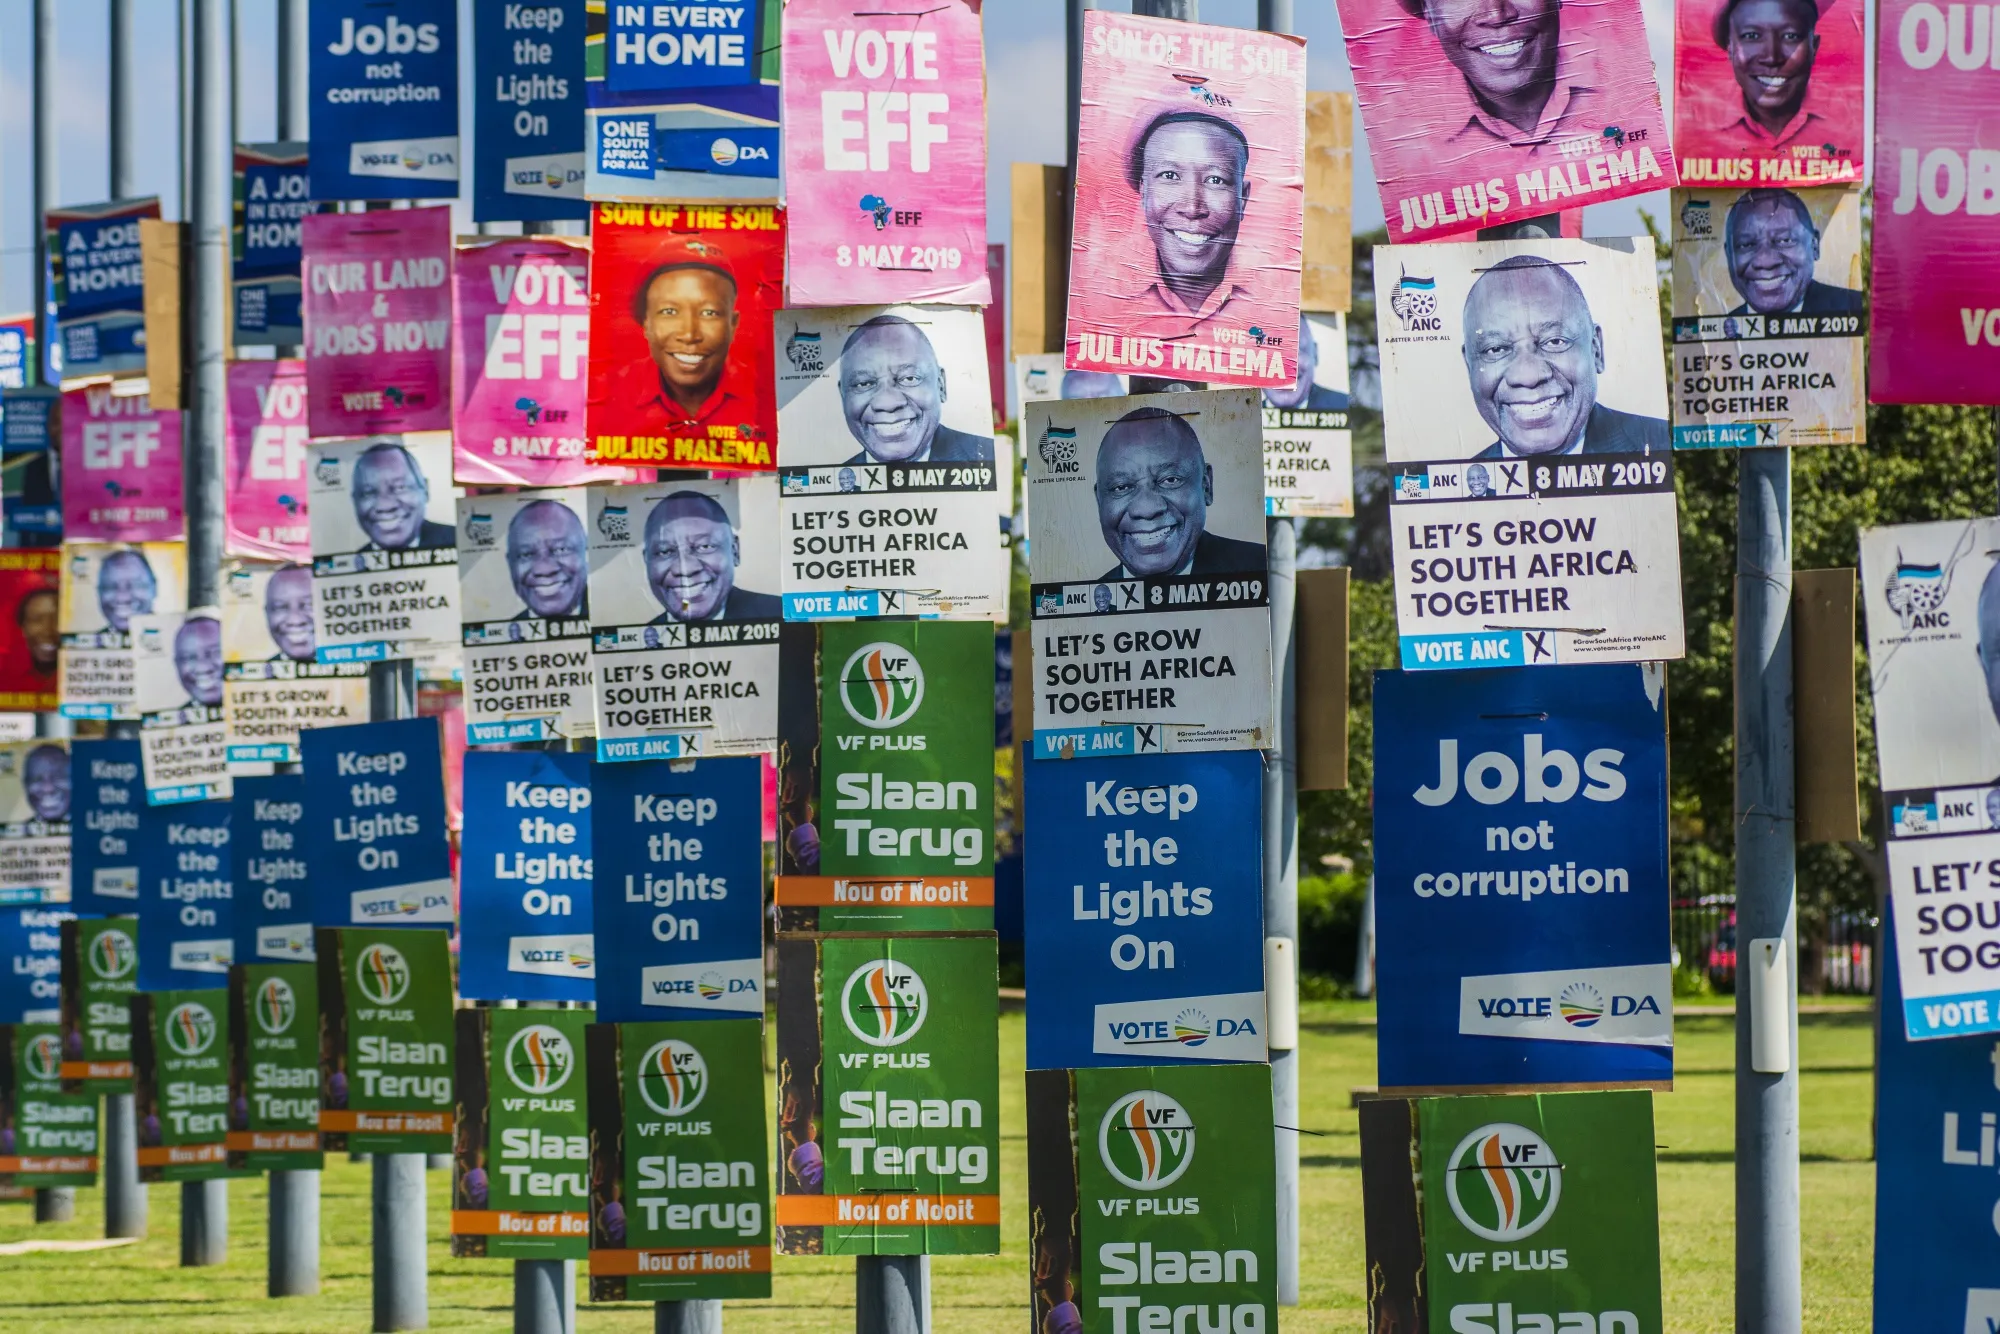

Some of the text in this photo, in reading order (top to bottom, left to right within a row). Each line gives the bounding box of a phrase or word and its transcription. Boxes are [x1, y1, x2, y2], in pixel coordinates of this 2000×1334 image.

[505, 4, 564, 32] Keep
[617, 6, 745, 28] IN EVERY
[328, 16, 439, 54] Jobs
[513, 39, 552, 64] the
[616, 33, 744, 66] HOME
[823, 30, 939, 80] VOTE
[1092, 26, 1298, 76] SON OF THE SOIL
[366, 61, 402, 78] not
[327, 84, 440, 104] corruption
[496, 75, 568, 105] Lights
[1215, 94, 1232, 108] EFF
[514, 111, 548, 136] On
[603, 121, 649, 137] ONE
[821, 91, 949, 172] EFF
[603, 138, 648, 150] SOUTH
[603, 150, 648, 160] AFRICA
[740, 146, 769, 160] DA
[1559, 129, 1648, 160] VOTE EFF
[1792, 145, 1820, 157] VOTE
[360, 152, 454, 165] VOTE DA
[603, 160, 648, 170] FOR ALL
[1681, 158, 1855, 181] JULIUS MALEMA
[512, 171, 543, 185] VOTE
[1400, 147, 1662, 233] JULIUS MALEMA
[600, 202, 780, 230] SON OF THE SOIL
[895, 212, 922, 225] EFF
[837, 246, 960, 269] 8 MAY 2019
[311, 257, 446, 294] OUR LAND
[489, 264, 588, 306] VOTE
[372, 294, 389, 318] &
[1412, 318, 1441, 331] ANC
[1769, 316, 1858, 333] 8 MAY 2019
[312, 320, 448, 357] JOBS NOW
[486, 314, 589, 380] EFF
[1213, 327, 1282, 346] VOTE EFF
[801, 361, 824, 372] ANC
[1076, 333, 1286, 380] JULIUS MALEMA
[1740, 352, 1809, 369] GROW
[1683, 372, 1836, 394] SOUTH AFRICA
[342, 392, 382, 411] VOTE
[1683, 396, 1789, 415] TOGETHER
[544, 410, 568, 422] EFF
[708, 426, 737, 440] VOTE
[82, 421, 160, 470] EFF
[595, 436, 771, 464] JULIUS MALEMA
[812, 468, 992, 487] ANC 8 MAY 2019
[1056, 462, 1080, 473] ANC
[1433, 462, 1666, 489] ANC 8 MAY 2019
[792, 508, 938, 530] LET'S GROW
[792, 532, 968, 556] SOUTH AFRICA
[1408, 518, 1596, 550] LET'S GROW
[792, 559, 916, 580] TOGETHER
[1410, 550, 1638, 584] SOUTH AFRICA
[1066, 580, 1262, 604] ANC 8 MAY 2019
[1411, 587, 1571, 618] TOGETHER
[793, 596, 868, 612] VOTE ANC
[1913, 612, 1950, 628] ANC
[1046, 628, 1201, 658] LET'S GROW
[1414, 639, 1510, 662] VOTE ANC
[1573, 637, 1632, 645] #GrowSouthAfrica
[661, 661, 732, 679] GROW
[1046, 656, 1236, 686] SOUTH AFRICA
[604, 681, 760, 705] SOUTH AFRICA
[1046, 688, 1176, 714] TOGETHER
[605, 706, 712, 727] TOGETHER
[836, 736, 926, 750] VF PLUS
[1092, 732, 1124, 749] ANC
[1412, 733, 1627, 806] Jobs
[836, 773, 977, 810] Slaan
[1086, 780, 1198, 820] Keep
[1943, 803, 1974, 818] ANC
[168, 825, 230, 847] Keep
[834, 820, 982, 866] Terug
[1486, 820, 1554, 851] not
[1104, 830, 1178, 867] the
[178, 852, 219, 872] the
[161, 879, 232, 902] Lights
[834, 880, 968, 902] Nou of Nooit
[1414, 862, 1628, 901] corruption
[1074, 881, 1213, 926] Lights
[180, 907, 216, 926] On
[1110, 934, 1174, 970] On
[1478, 996, 1661, 1018] VOTE DA
[1923, 1000, 1988, 1029] VOTE
[1108, 1018, 1257, 1040] VOTE DA
[357, 1036, 446, 1064] Slaan
[839, 1053, 930, 1069] VF PLUS
[356, 1070, 450, 1104] Terug
[839, 1091, 982, 1128] Slaan
[838, 1138, 988, 1183] Terug
[637, 1156, 755, 1189] Slaan
[636, 1197, 762, 1237] Terug
